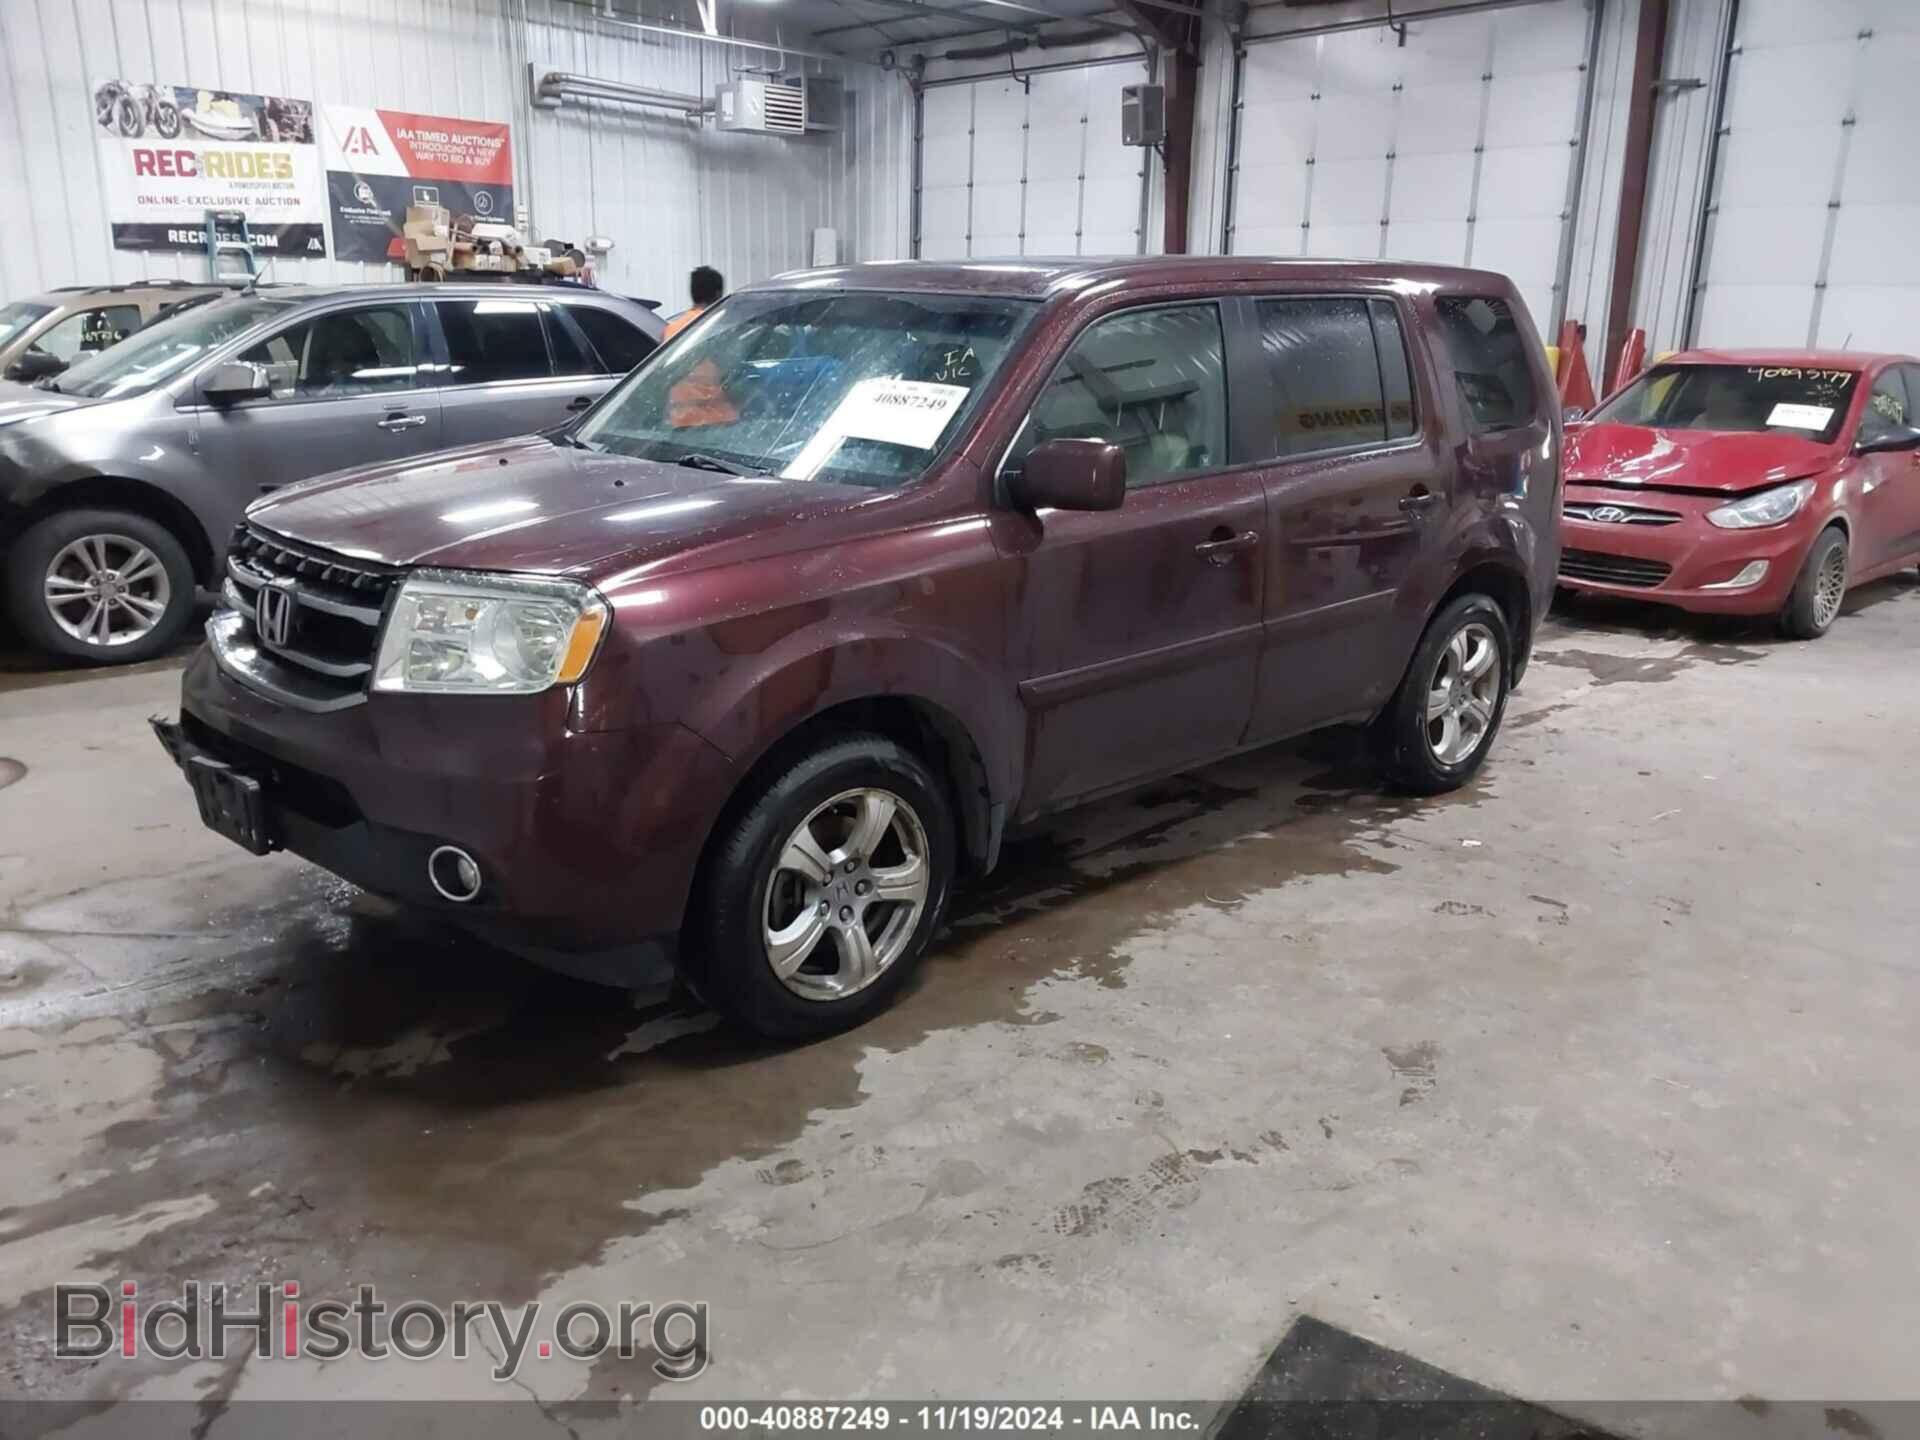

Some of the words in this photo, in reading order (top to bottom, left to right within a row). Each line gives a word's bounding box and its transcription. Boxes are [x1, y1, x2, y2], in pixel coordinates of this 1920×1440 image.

[397, 127, 414, 139] IAA
[415, 130, 448, 143] TIMED
[133, 148, 198, 177] REC
[204, 150, 294, 179] RIDES
[416, 151, 433, 161] WAY
[435, 152, 449, 162] TO
[137, 195, 250, 206] ONLINE-EXCLUSIVE
[255, 196, 301, 206] AUCTION
[873, 392, 948, 408] 40887249
